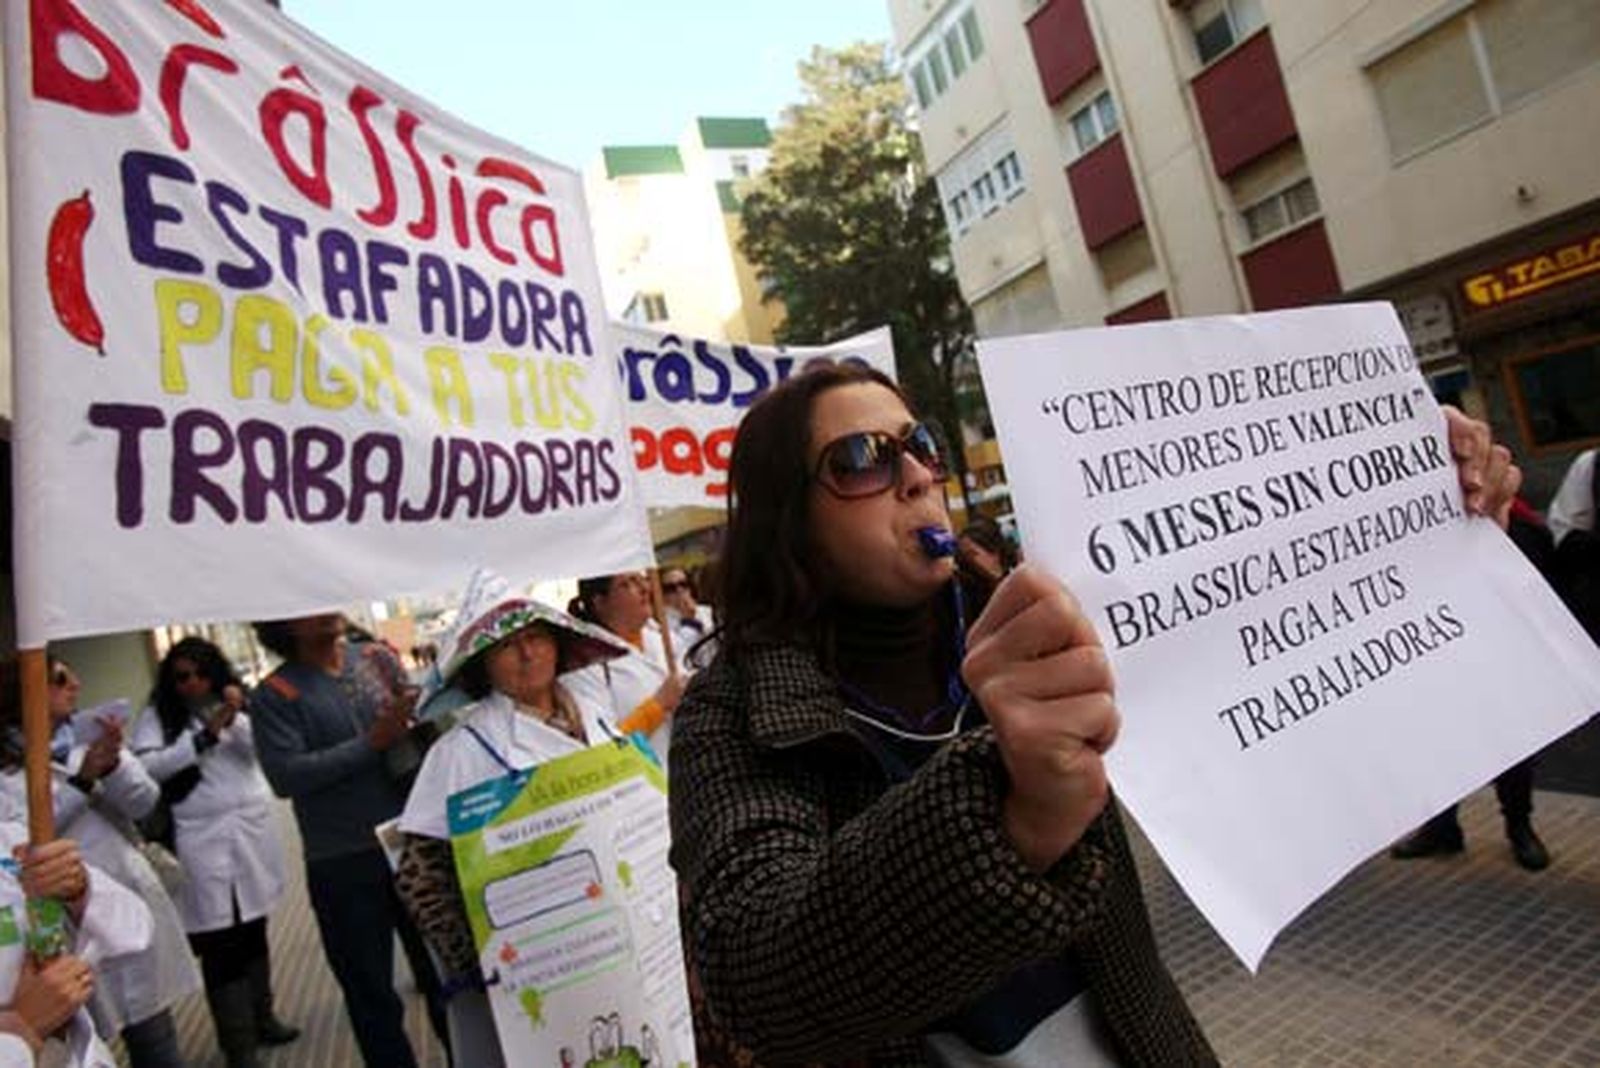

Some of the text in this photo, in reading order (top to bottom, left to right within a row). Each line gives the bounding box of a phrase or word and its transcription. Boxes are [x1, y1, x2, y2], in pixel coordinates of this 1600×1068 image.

[120, 150, 593, 356] ESTAFADORA
[154, 278, 595, 432] PAGA A TUS
[1208, 369, 1249, 408] DE
[1254, 347, 1396, 400] RECEPCION
[88, 403, 621, 528] TRABAJADORAS
[1080, 426, 1243, 498] MENORES
[1246, 419, 1287, 457] DE
[1087, 434, 1447, 575] 6 MESES SIN COBRAR
[1104, 490, 1462, 650] BRASSICA ESTAFADORA.
[1238, 563, 1407, 668] PAGA A TUS
[1218, 603, 1466, 752] TRABAJADORAS
